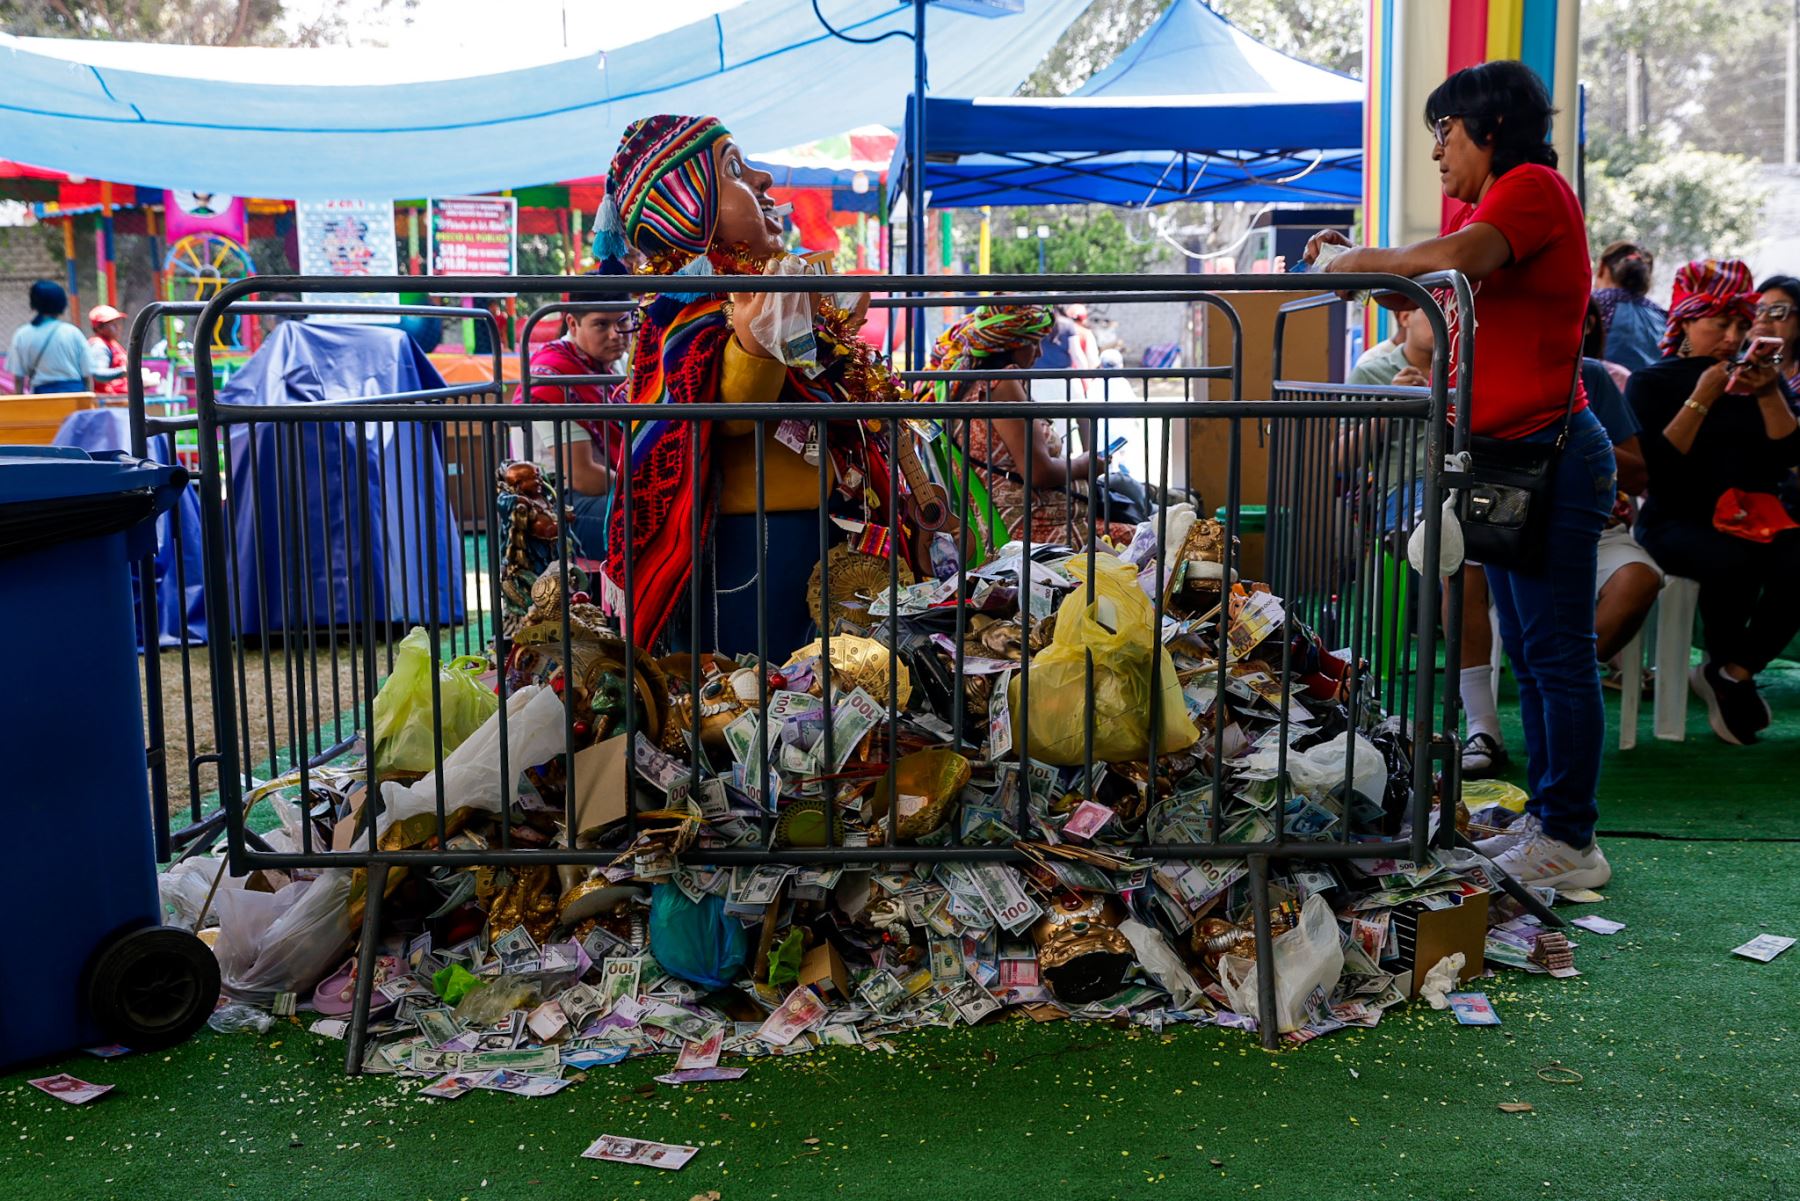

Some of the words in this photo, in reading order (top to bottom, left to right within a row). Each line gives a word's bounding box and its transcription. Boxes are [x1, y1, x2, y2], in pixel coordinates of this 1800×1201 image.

[774, 695, 790, 714] 100
[850, 695, 876, 720] 100
[1399, 862, 1414, 871] 500
[679, 873, 701, 894] 100
[1000, 901, 1028, 922] 100
[608, 962, 635, 975] 100
[1306, 993, 1324, 1012] 100
[462, 1055, 479, 1070] 100
